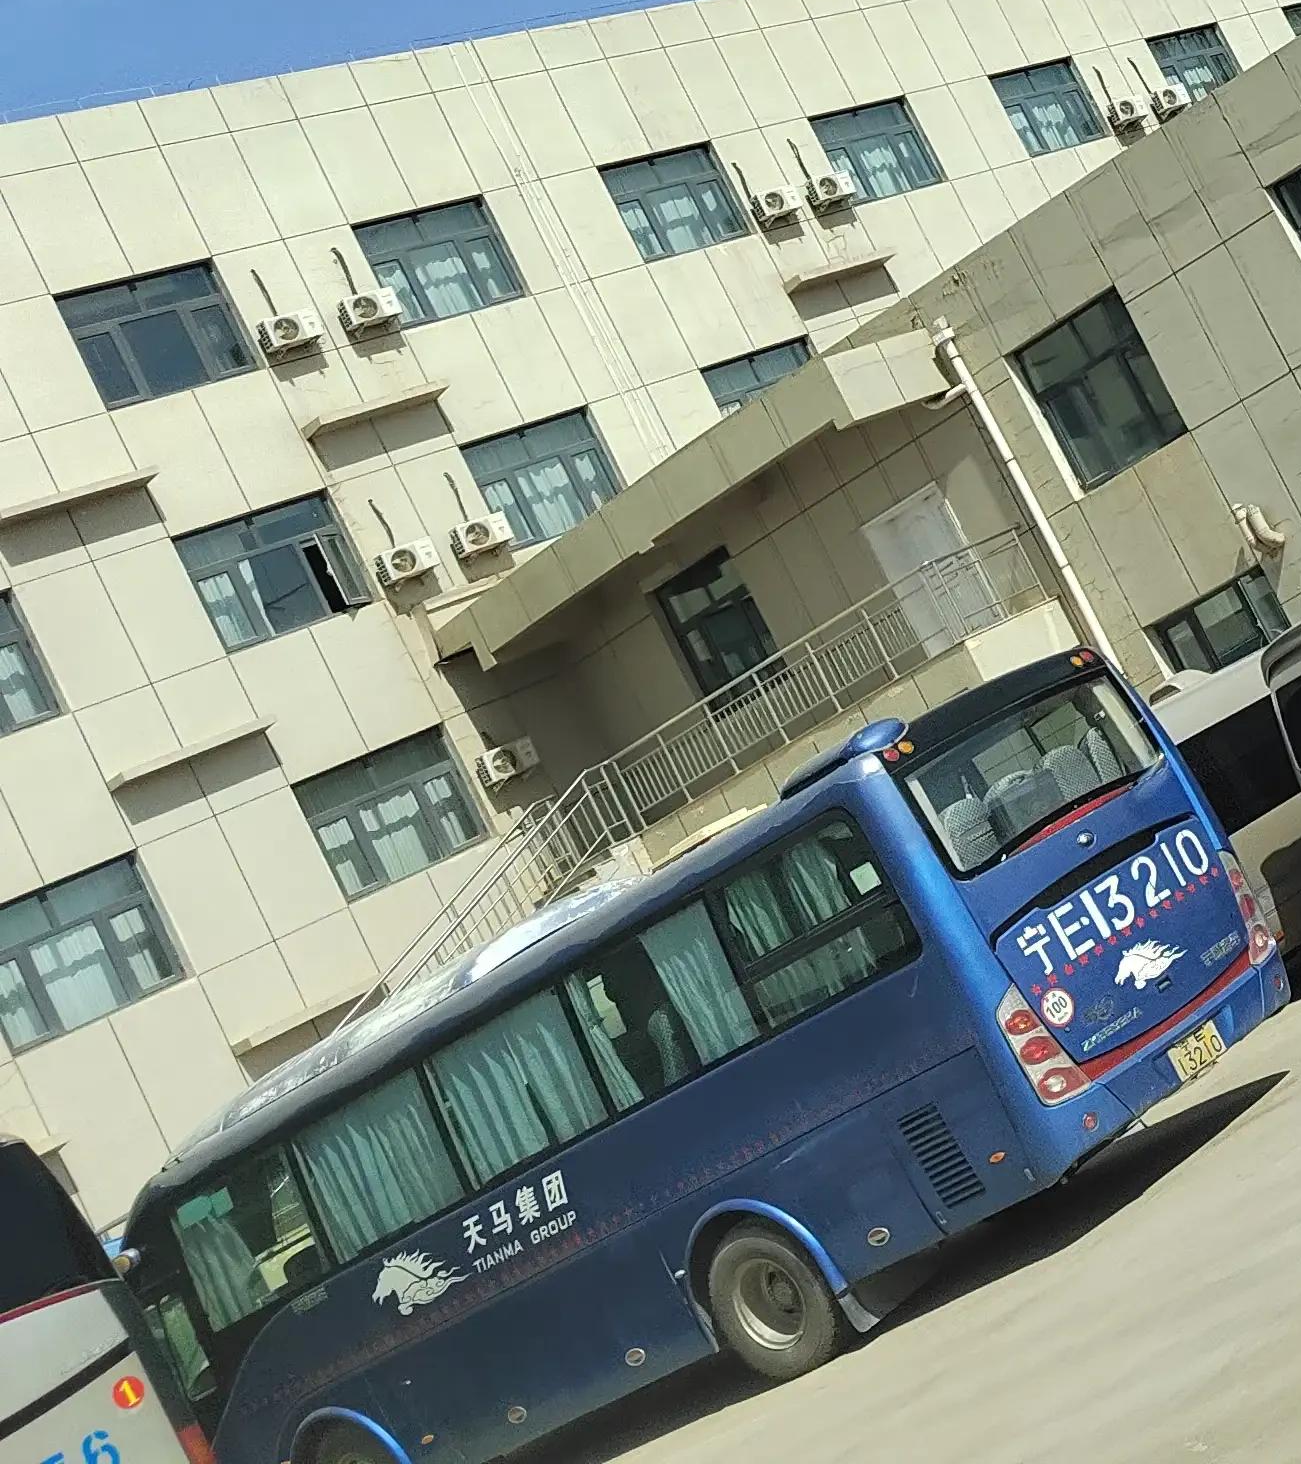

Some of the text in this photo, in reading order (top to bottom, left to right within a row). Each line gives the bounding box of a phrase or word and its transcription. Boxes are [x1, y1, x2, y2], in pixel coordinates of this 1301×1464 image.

[1045, 995, 1068, 1019] 100
[1178, 1034, 1222, 1076] 13210
[462, 1170, 568, 1254] 天马集团
[472, 1210, 577, 1273] TIANMA GROUP
[119, 1380, 140, 1407] 1
[40, 1430, 120, 1464] 6
